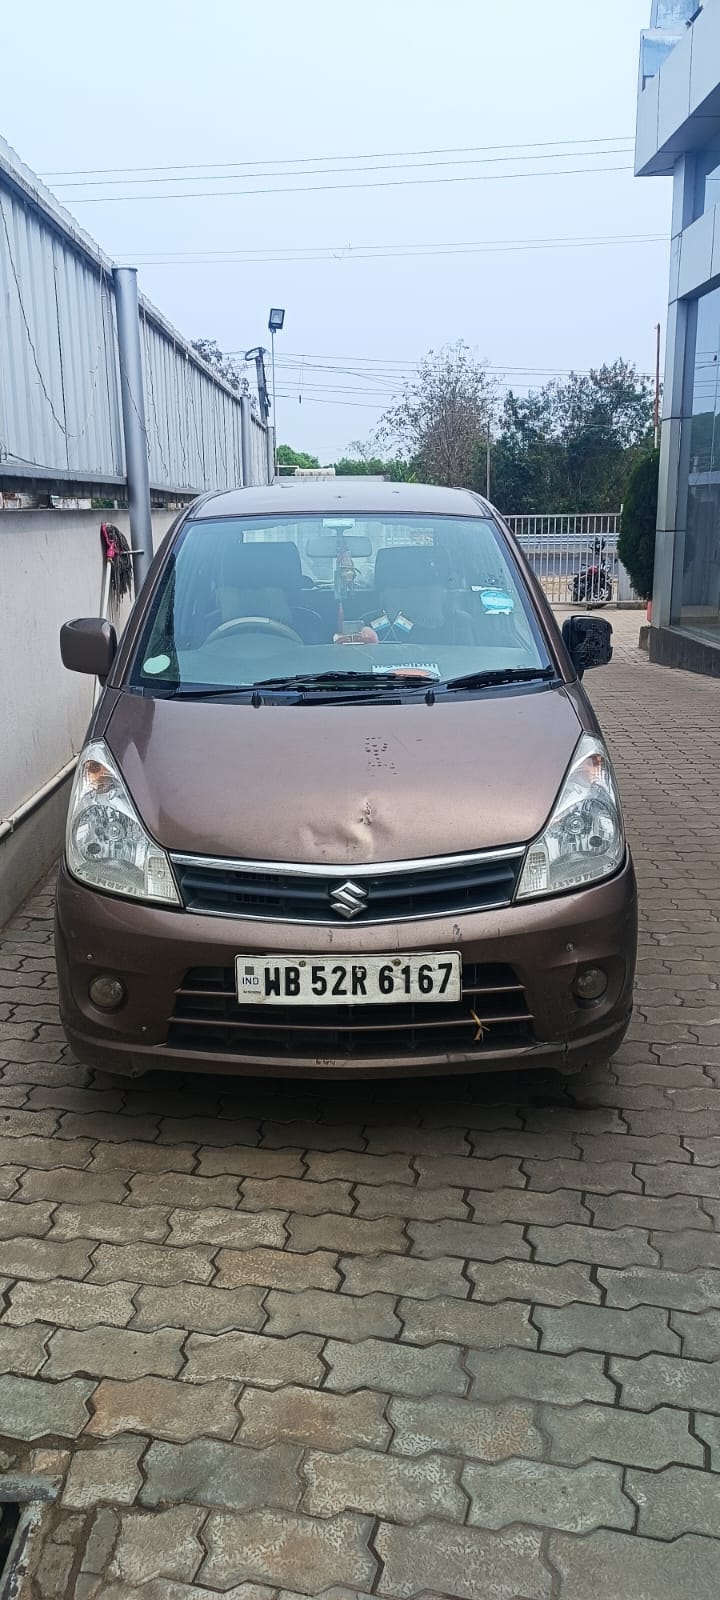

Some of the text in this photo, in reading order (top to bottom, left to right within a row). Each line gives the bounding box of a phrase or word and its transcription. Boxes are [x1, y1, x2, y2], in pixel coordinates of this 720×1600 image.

[242, 977, 259, 985] IND
[264, 962, 453, 997] WB 52R 6167
